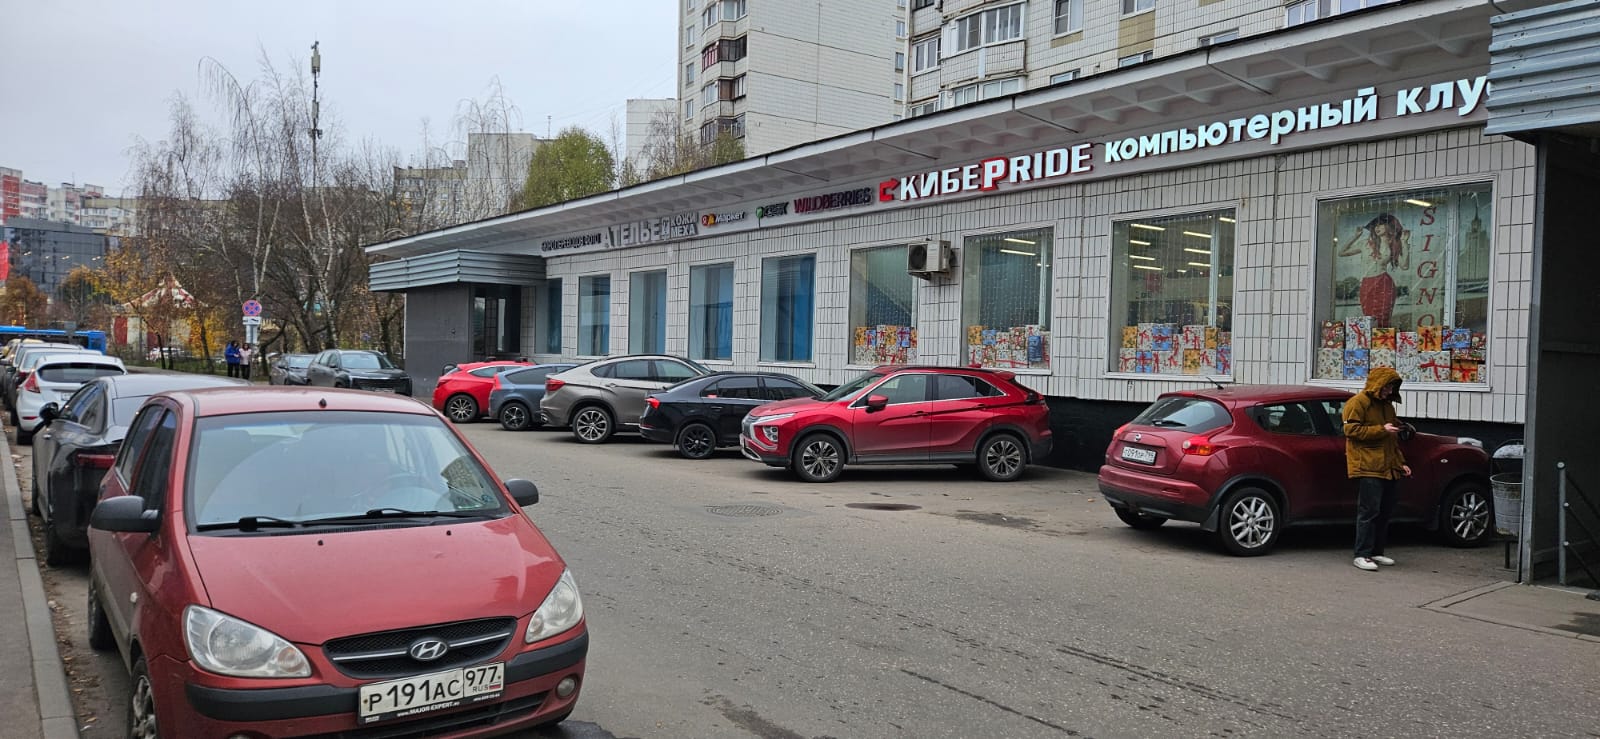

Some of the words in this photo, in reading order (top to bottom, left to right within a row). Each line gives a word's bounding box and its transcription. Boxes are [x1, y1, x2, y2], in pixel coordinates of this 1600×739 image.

[1104, 87, 1377, 163] компьютерный
[1396, 75, 1490, 116] клу
[794, 187, 872, 213] WILDBERRIES
[670, 212, 696, 227] КОЖИ
[670, 223, 696, 237] МЕХА
[601, 217, 660, 249] АТЕЛЬЕ
[465, 666, 498, 687] 977
[472, 684, 489, 693] RUS
